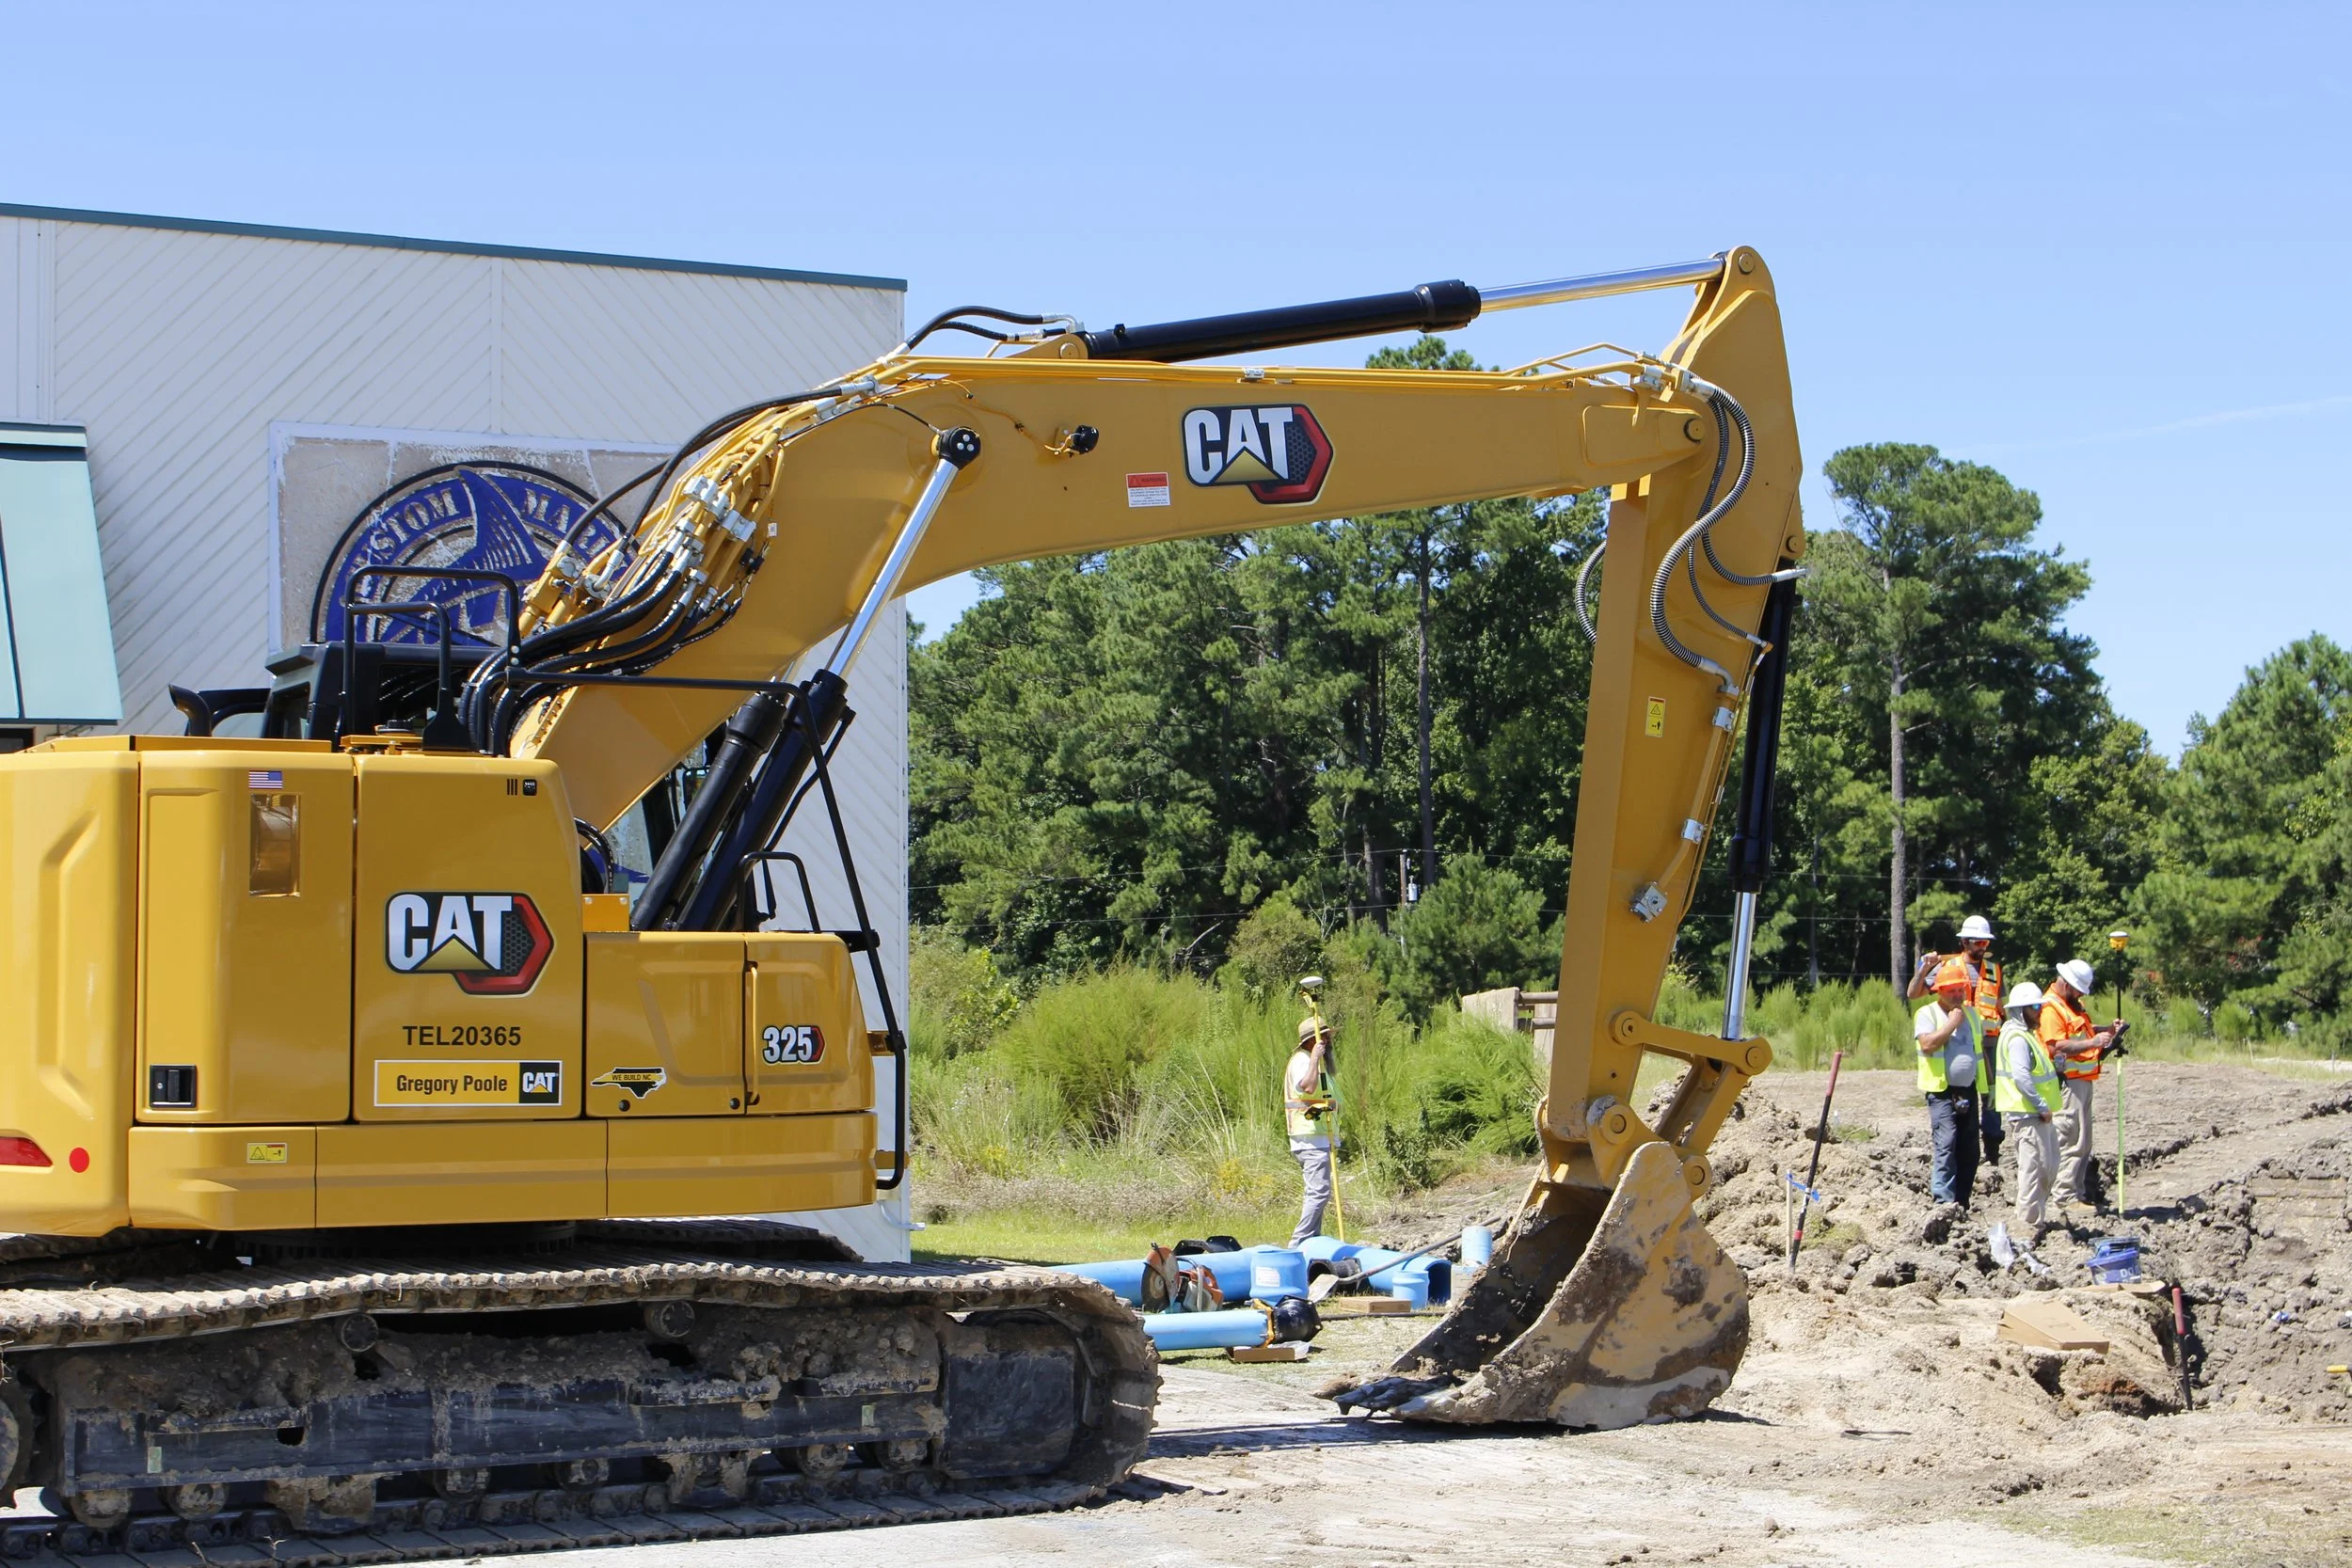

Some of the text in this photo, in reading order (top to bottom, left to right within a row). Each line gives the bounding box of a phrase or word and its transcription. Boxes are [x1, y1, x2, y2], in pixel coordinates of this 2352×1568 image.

[1184, 407, 1293, 483] CAT
[388, 894, 512, 971] CAT
[402, 1025, 521, 1046] TEL20365
[763, 1026, 812, 1062] 325
[396, 1074, 508, 1095] Gregory Poole
[522, 1071, 557, 1093] CAT
